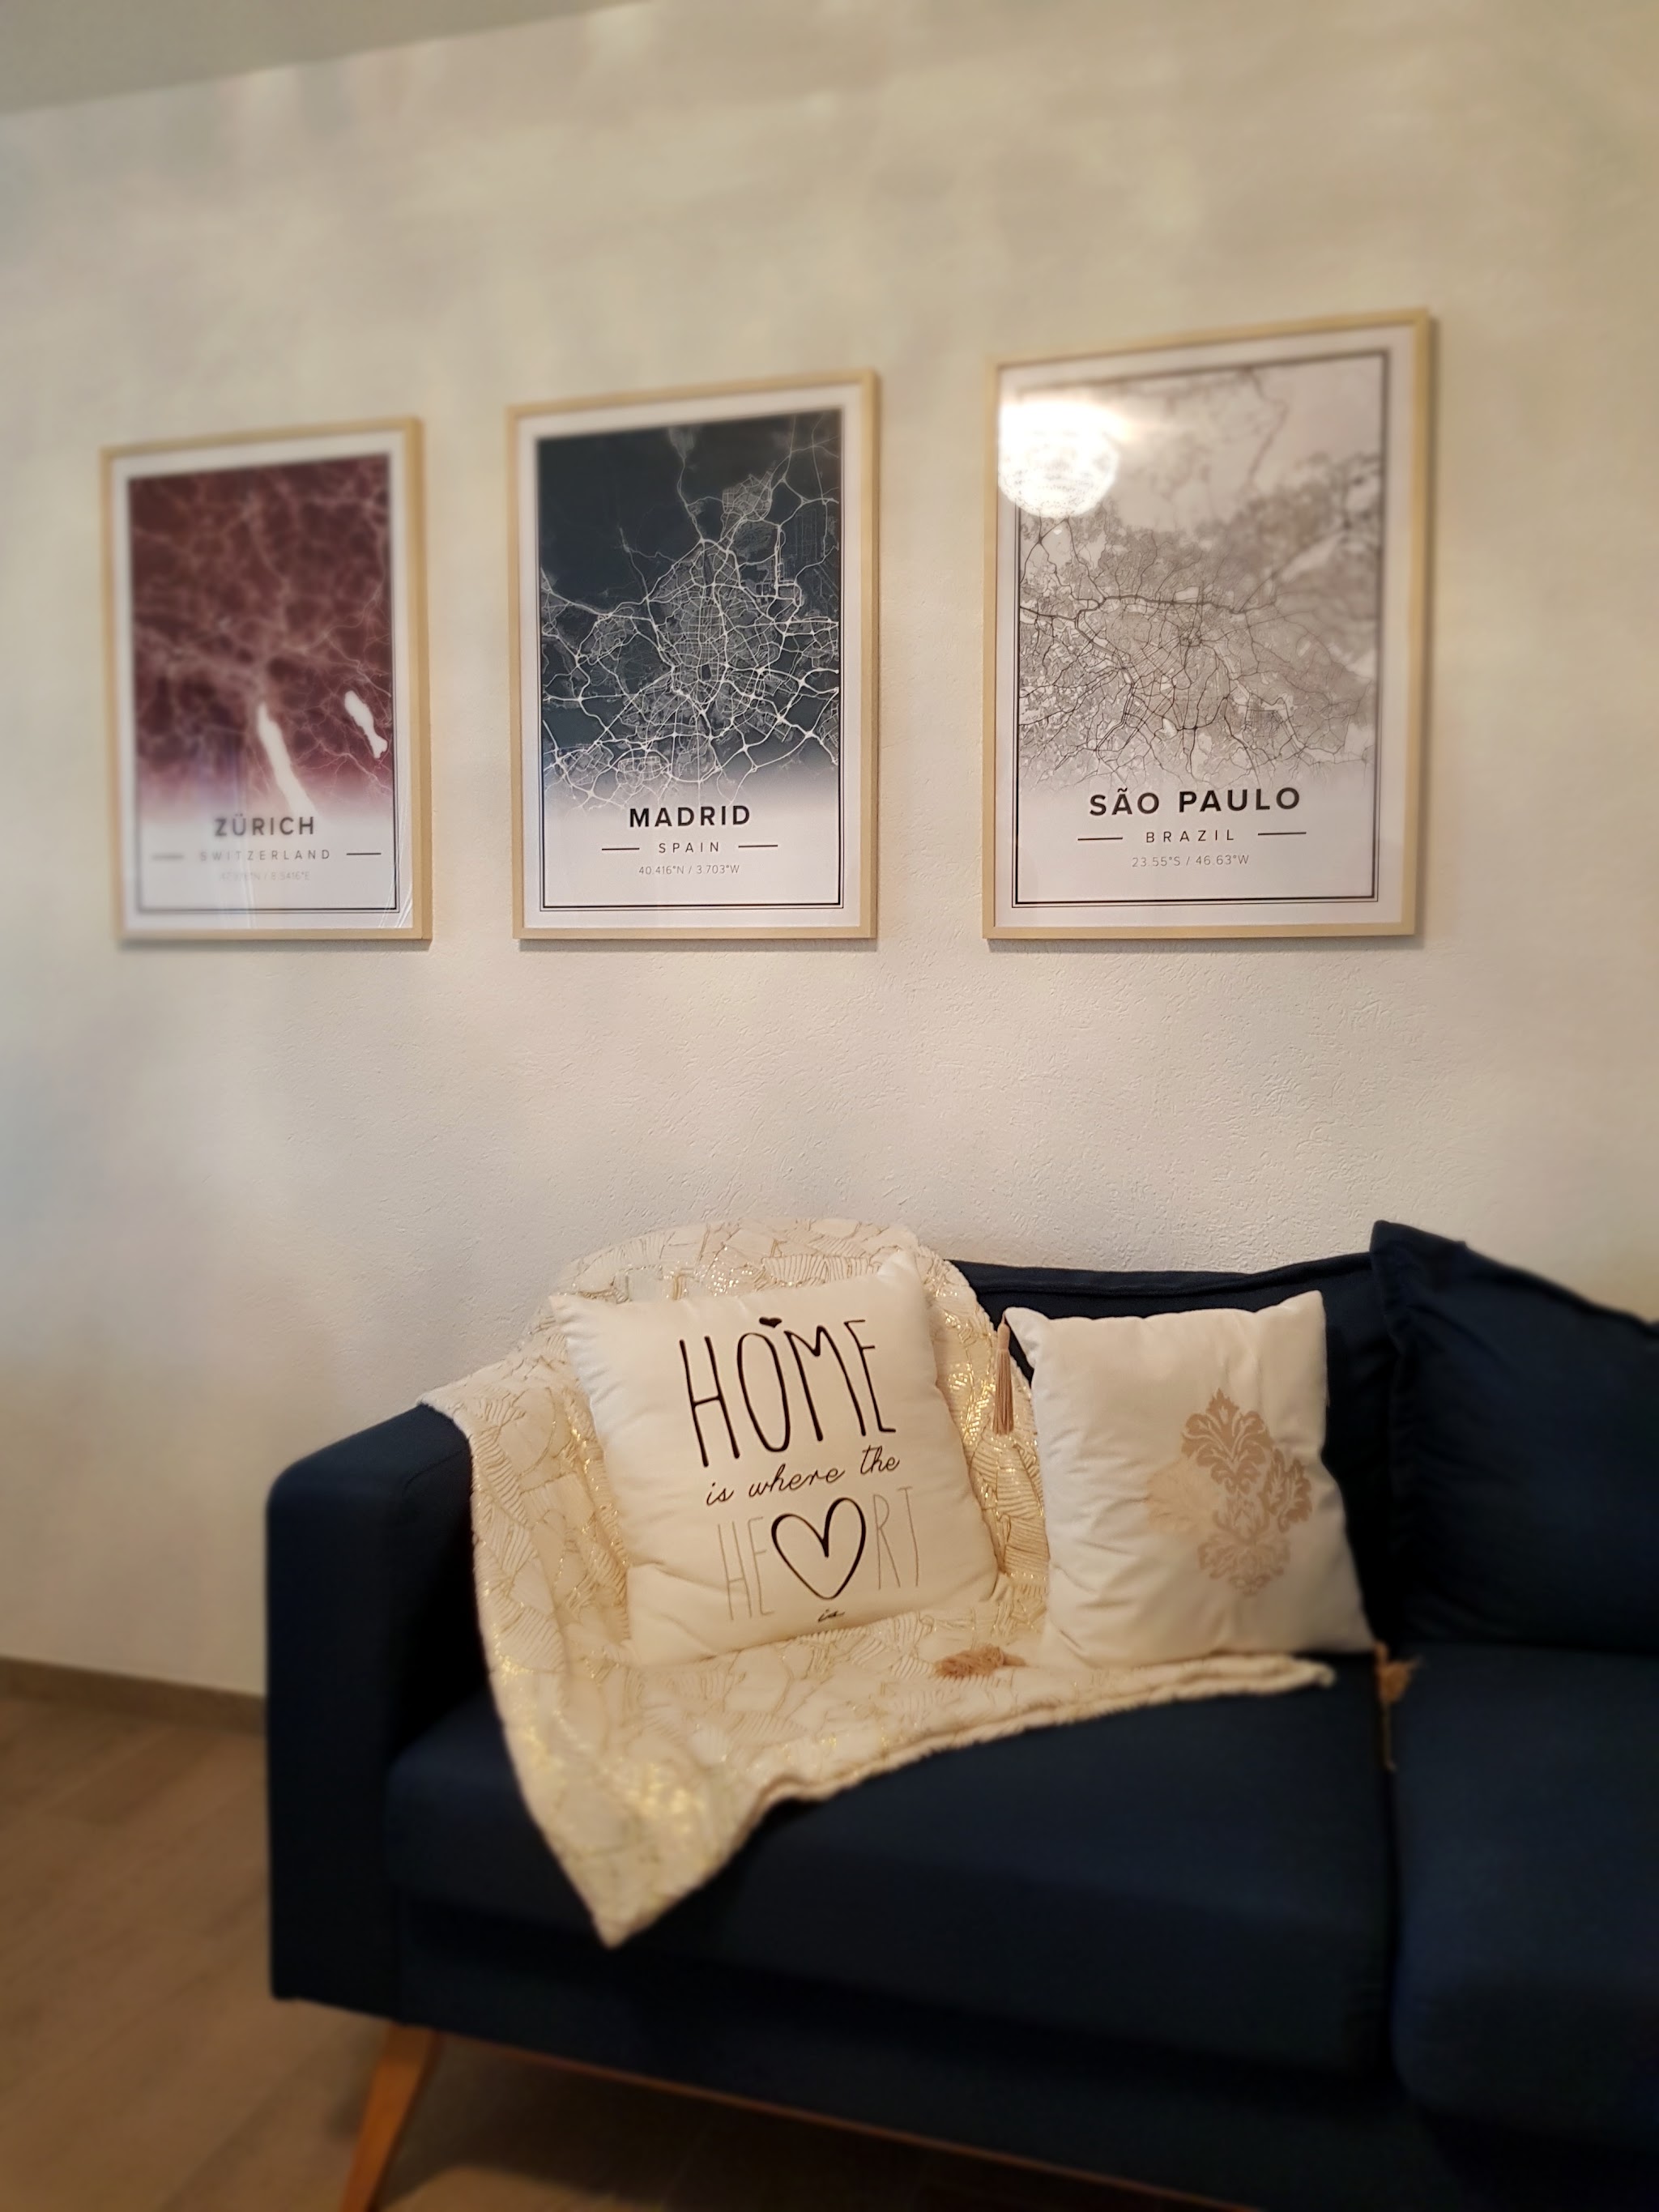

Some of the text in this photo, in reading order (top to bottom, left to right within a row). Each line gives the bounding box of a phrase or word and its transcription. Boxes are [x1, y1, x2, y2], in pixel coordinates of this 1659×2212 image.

[1089, 786, 1301, 816] SÃO PAULO
[215, 813, 315, 837] ZÜRICH
[629, 805, 750, 828] MADRID
[659, 842, 719, 854] SPAIN
[1145, 829, 1235, 844] BRAZIL
[200, 849, 331, 861] SWITZERLAND
[1132, 856, 1182, 868] 23.55°S
[1195, 855, 1250, 866] 46.63°W
[679, 1318, 897, 1468] HOME
[706, 1445, 900, 1507] is where the
